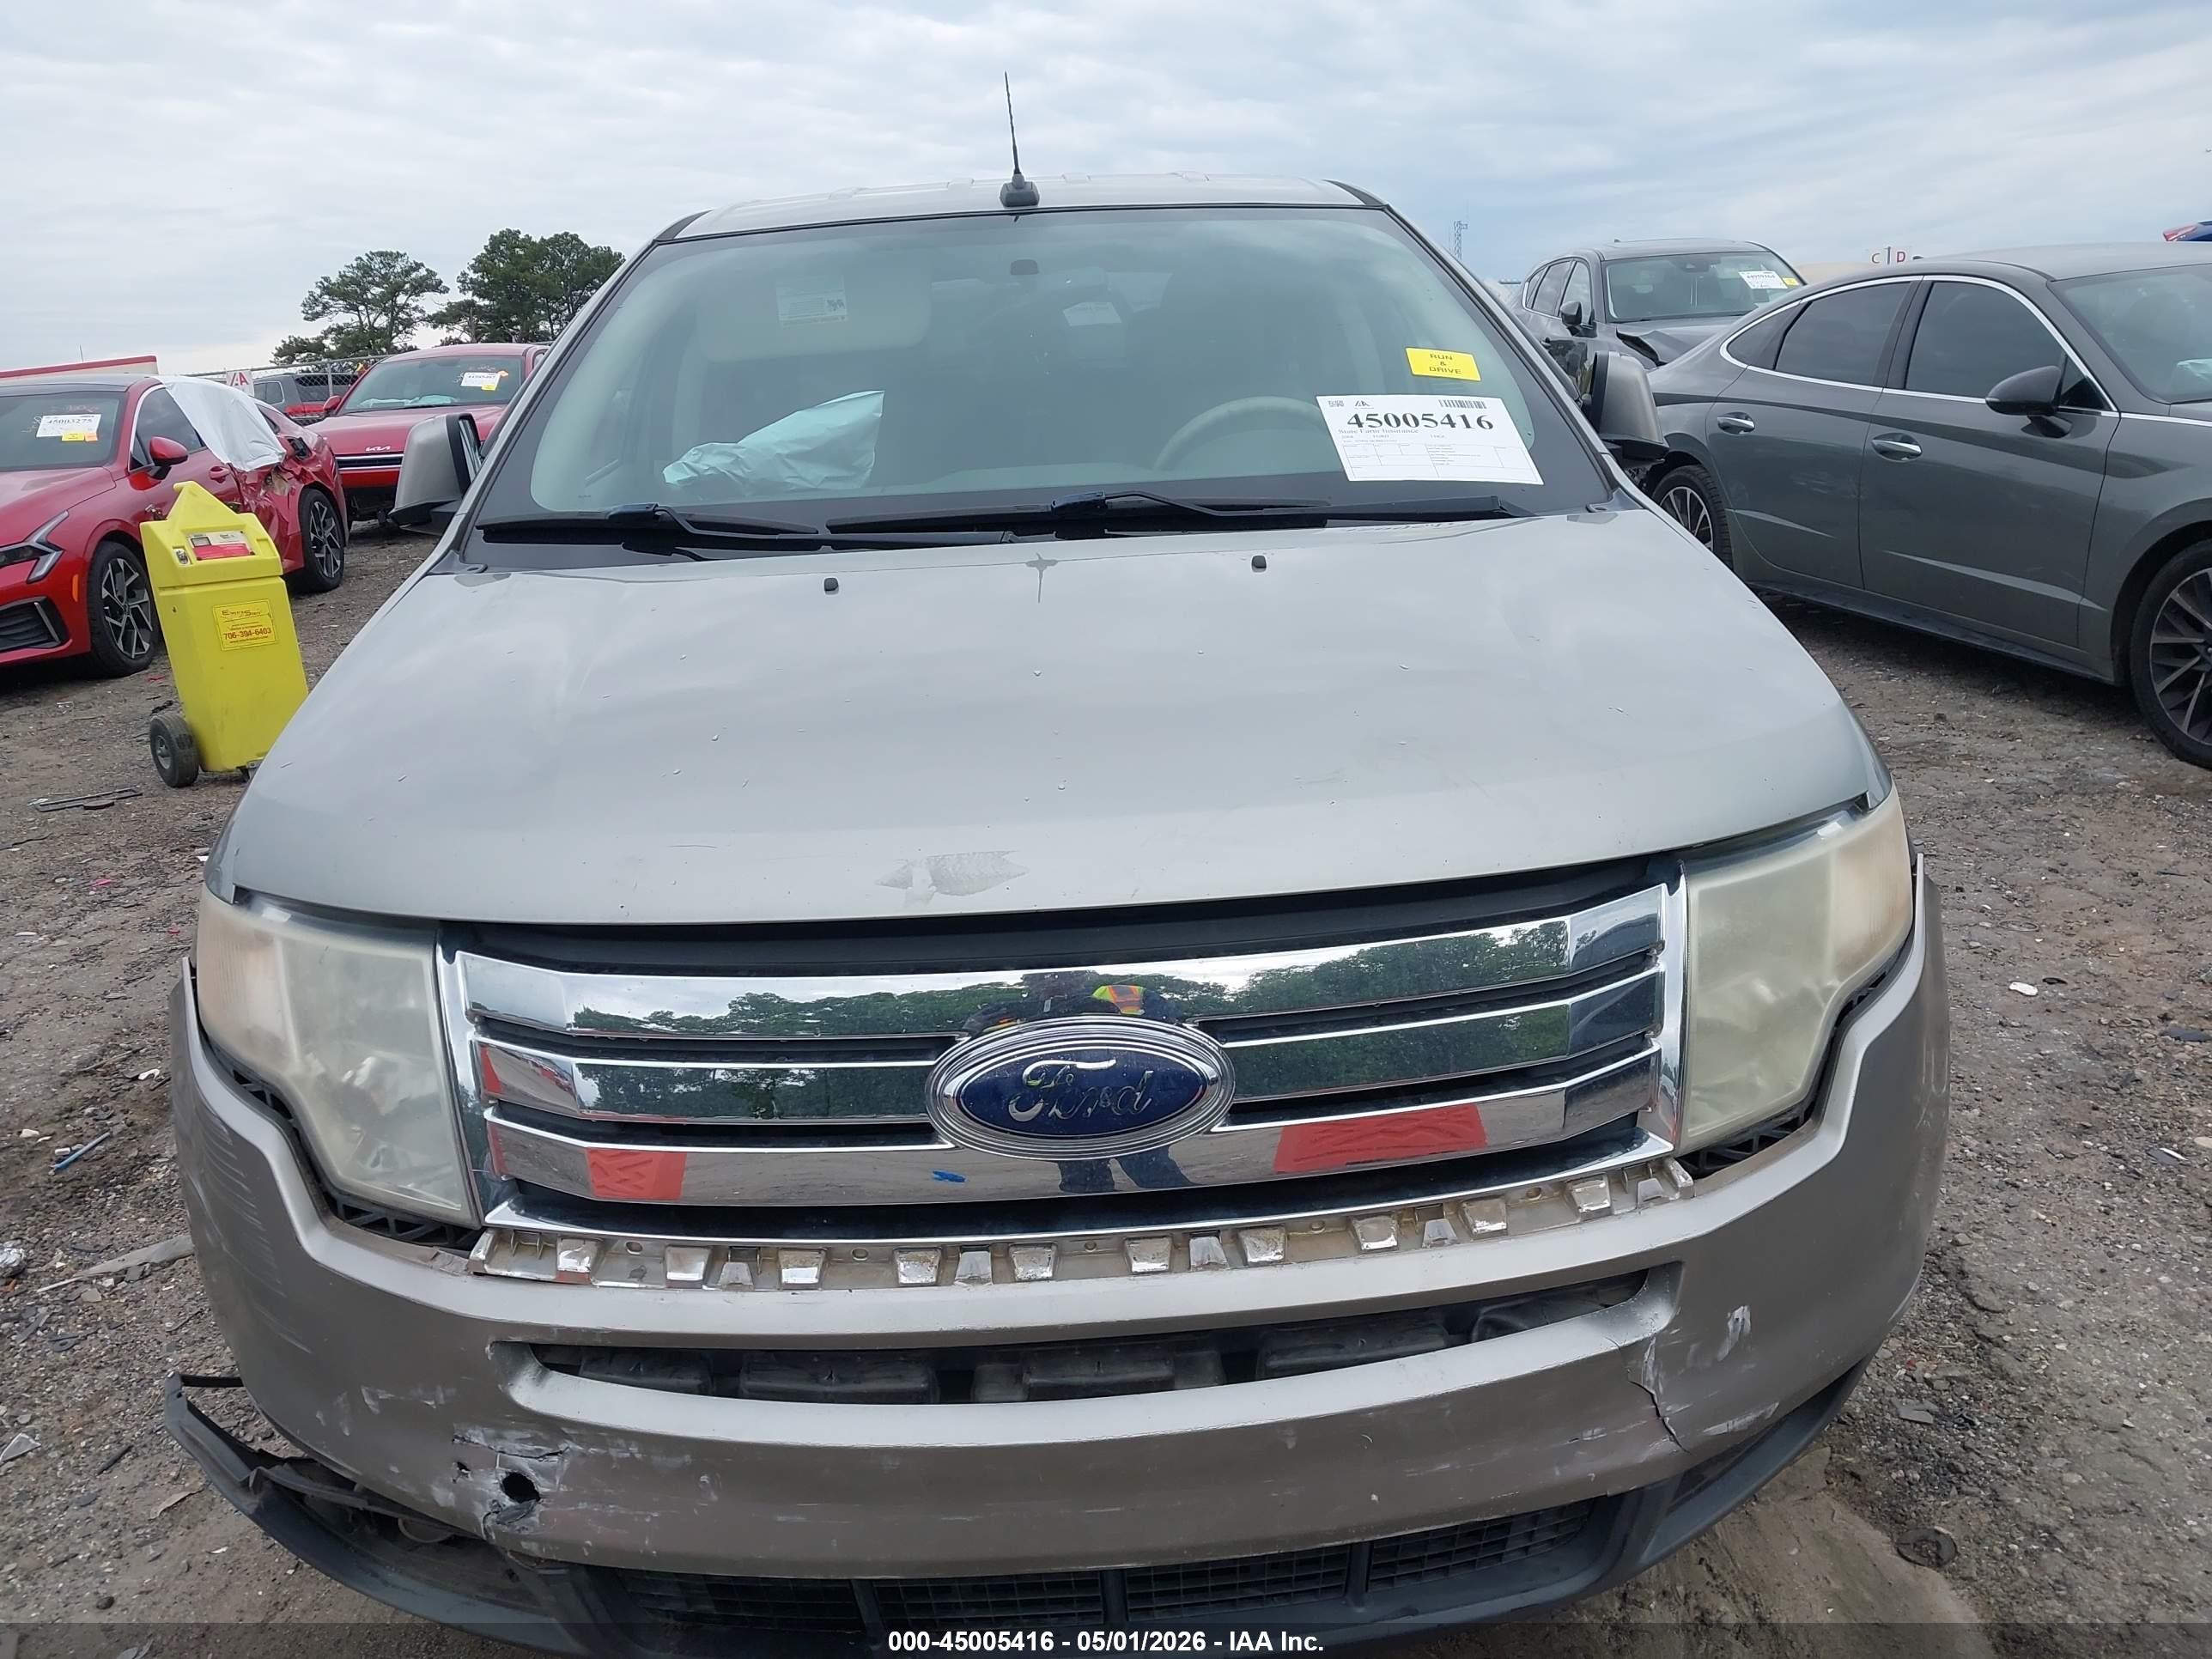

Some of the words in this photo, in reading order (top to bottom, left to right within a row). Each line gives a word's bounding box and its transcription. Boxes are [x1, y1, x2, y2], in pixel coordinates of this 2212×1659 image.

[1896, 251, 1906, 263] D
[1429, 366, 1462, 374] DRIVE
[1346, 412, 1494, 430] 45005416
[223, 627, 272, 641] 706-394-6403
[1007, 1058, 1155, 1122] Ford
